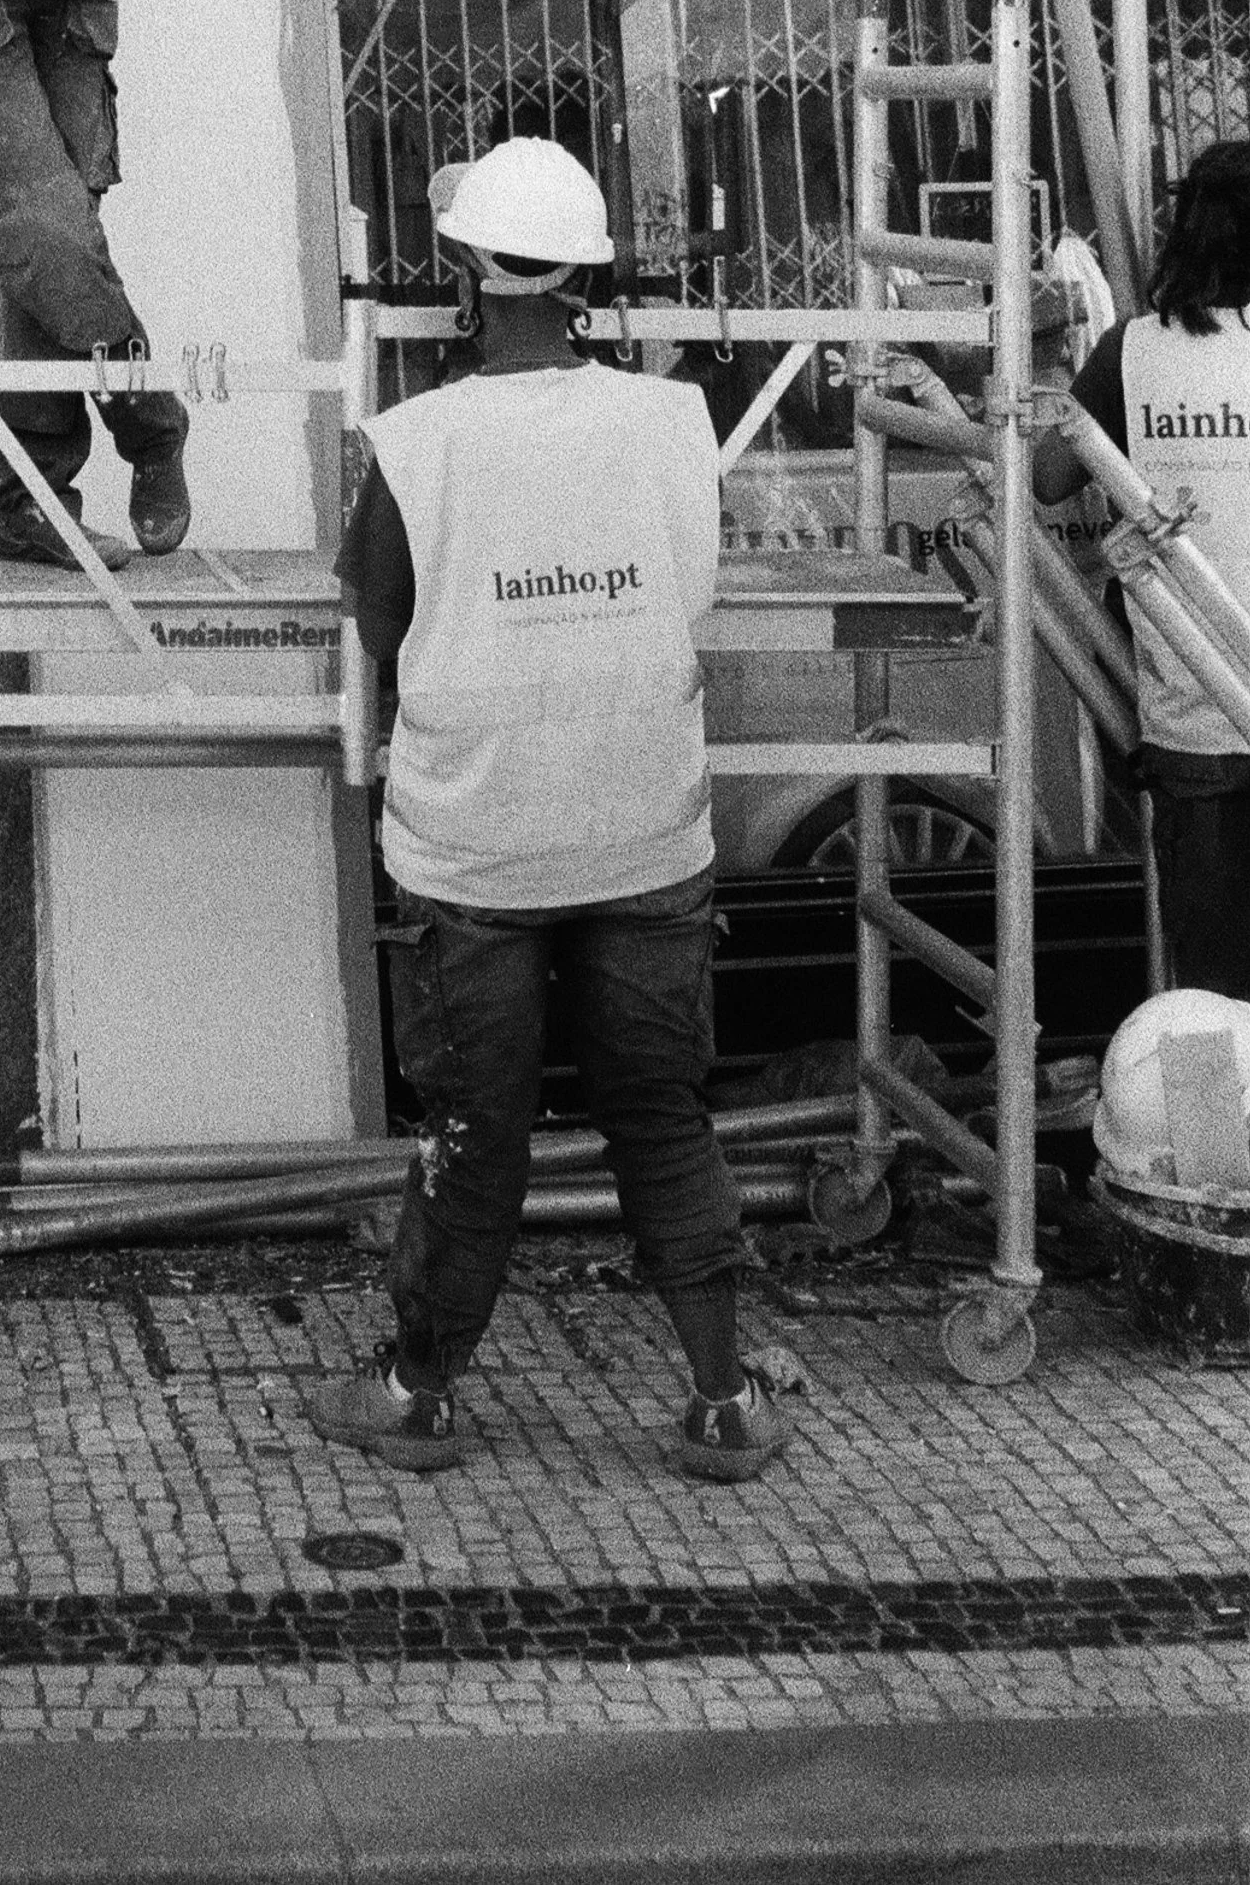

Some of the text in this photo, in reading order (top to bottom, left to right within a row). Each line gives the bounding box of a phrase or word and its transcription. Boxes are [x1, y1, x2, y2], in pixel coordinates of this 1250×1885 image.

[1141, 402, 1250, 439] lainh
[493, 564, 643, 601] lainho.pt
[150, 621, 342, 648] AndaimeRen
